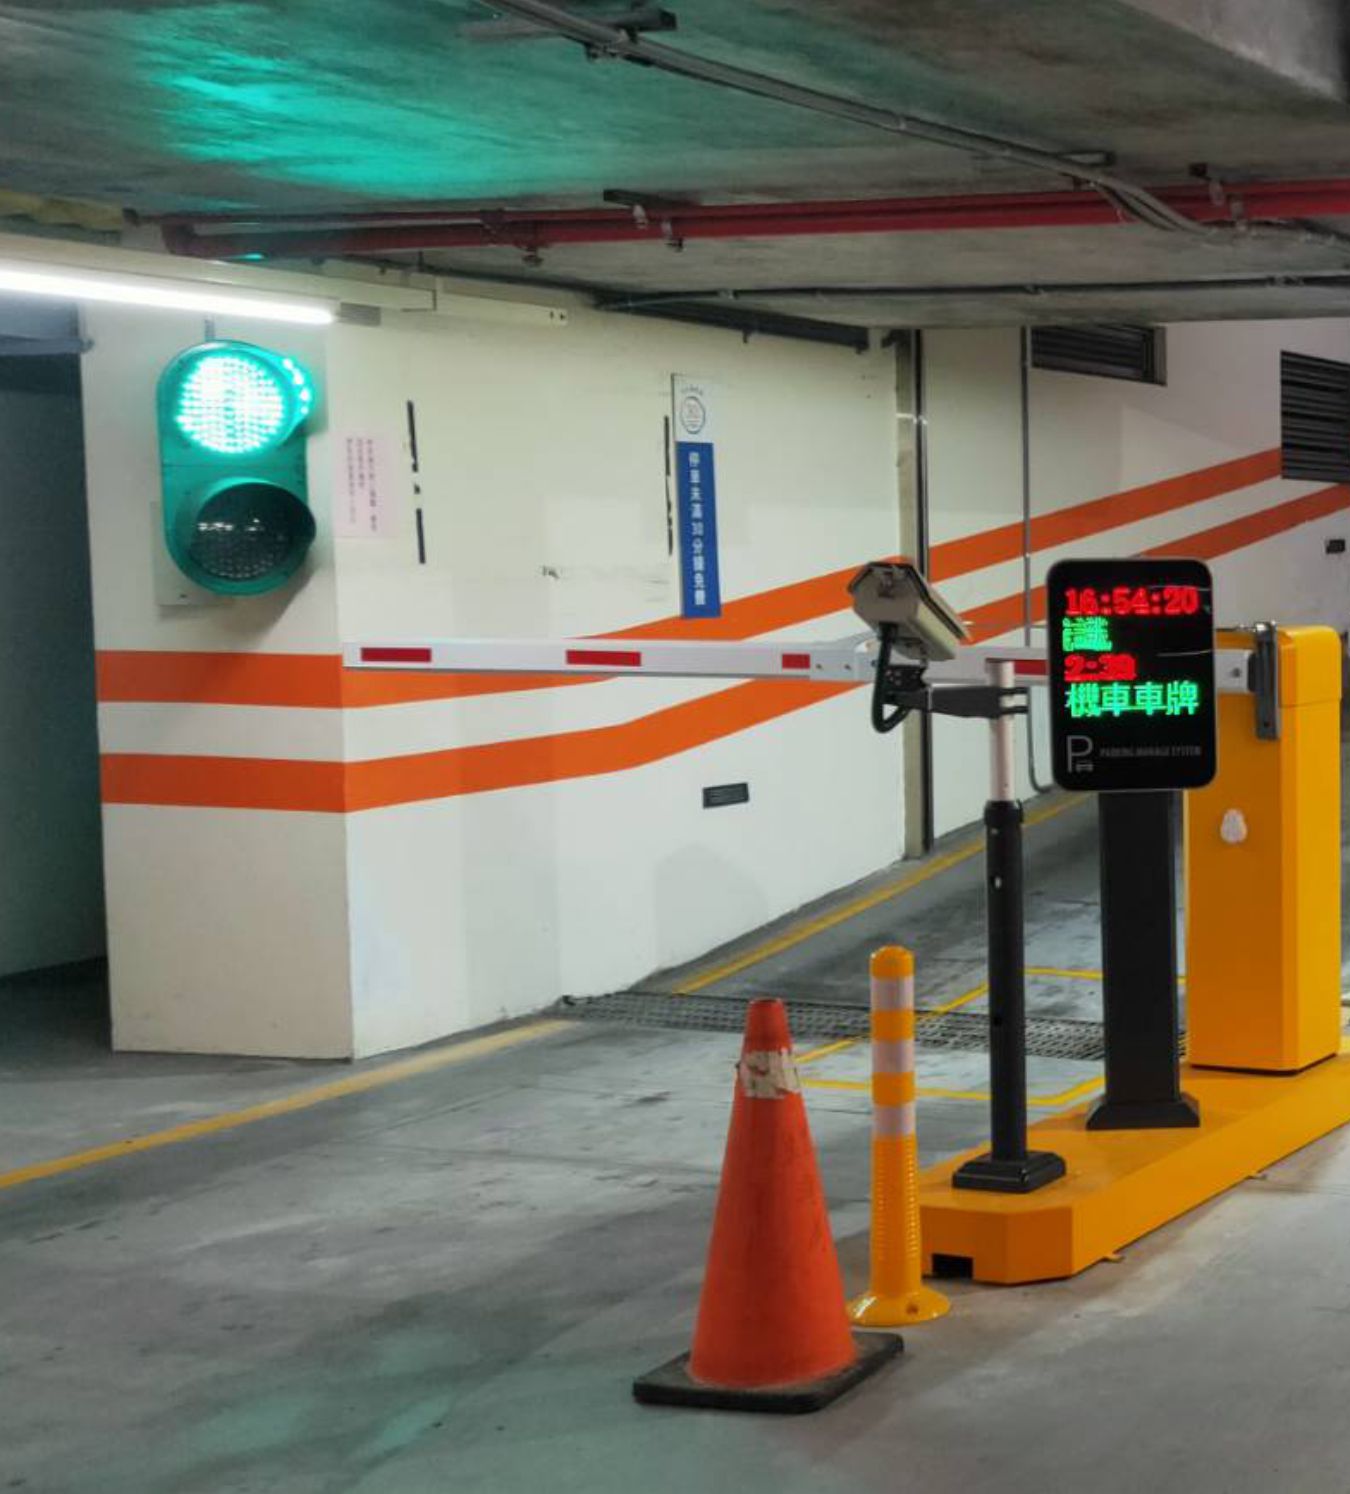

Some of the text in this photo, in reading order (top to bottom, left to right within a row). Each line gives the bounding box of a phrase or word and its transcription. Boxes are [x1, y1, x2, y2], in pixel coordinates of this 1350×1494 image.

[1065, 586, 1200, 616] 16:54:20
[1064, 680, 1199, 718] 機車車牌
